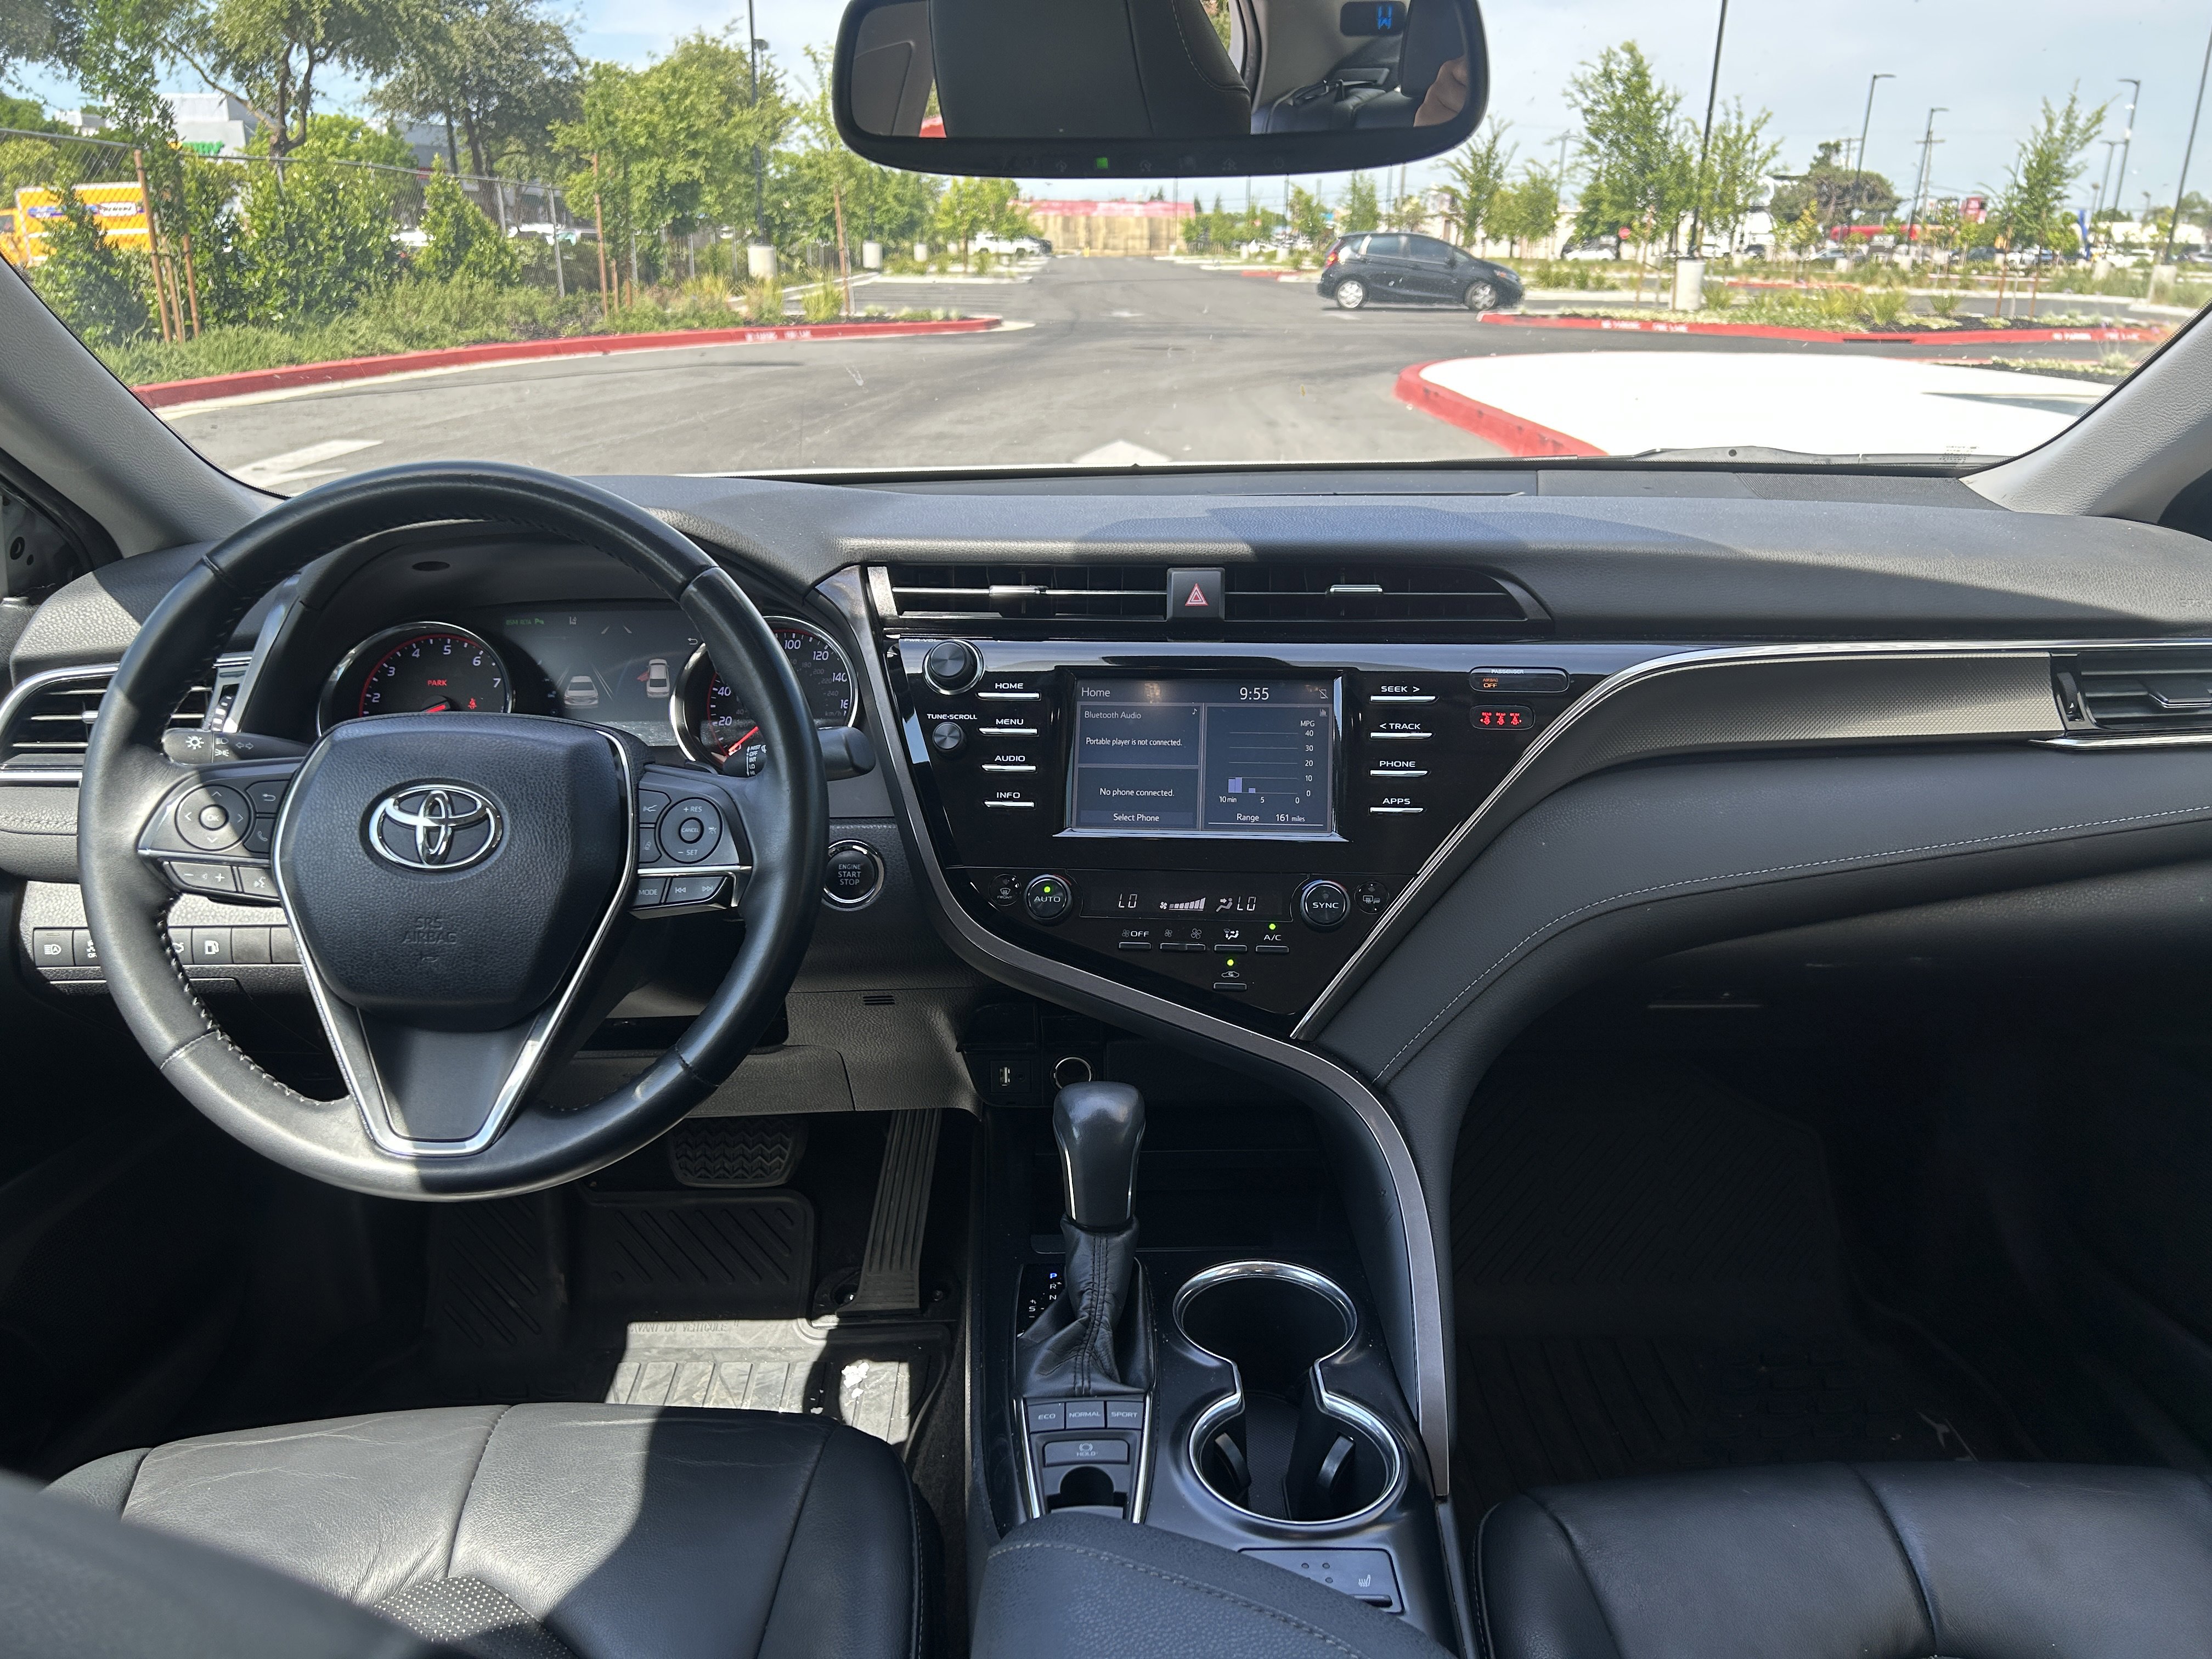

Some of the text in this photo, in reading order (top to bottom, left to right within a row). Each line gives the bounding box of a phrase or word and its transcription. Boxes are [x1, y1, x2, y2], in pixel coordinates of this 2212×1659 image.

[1378, 5, 1392, 30] W
[443, 645, 452, 655] 5
[785, 640, 801, 650] 100
[412, 649, 420, 658] 4
[812, 651, 829, 661] 120
[472, 656, 481, 666] 6
[387, 667, 396, 676] 3
[493, 678, 501, 687] 7
[718, 686, 731, 696] 40
[1081, 687, 1110, 697] Home
[1239, 687, 1269, 701] 9:55
[372, 693, 380, 703] 2
[1085, 711, 1119, 719] Bluetooth
[719, 716, 732, 726] 20
[1086, 737, 1110, 746] Portable
[1112, 738, 1130, 747] player
[1100, 788, 1174, 798] No phone connected.
[1113, 814, 1135, 822] Select
[1236, 814, 1260, 823] Range
[1276, 814, 1289, 822] 161
[1118, 894, 1138, 909] LO
[1237, 896, 1256, 912] LO
[1312, 900, 1340, 910] SYNC
[402, 930, 458, 945] AIRBAG
[1130, 929, 1149, 938] OFF
[1264, 933, 1282, 942] A/C
